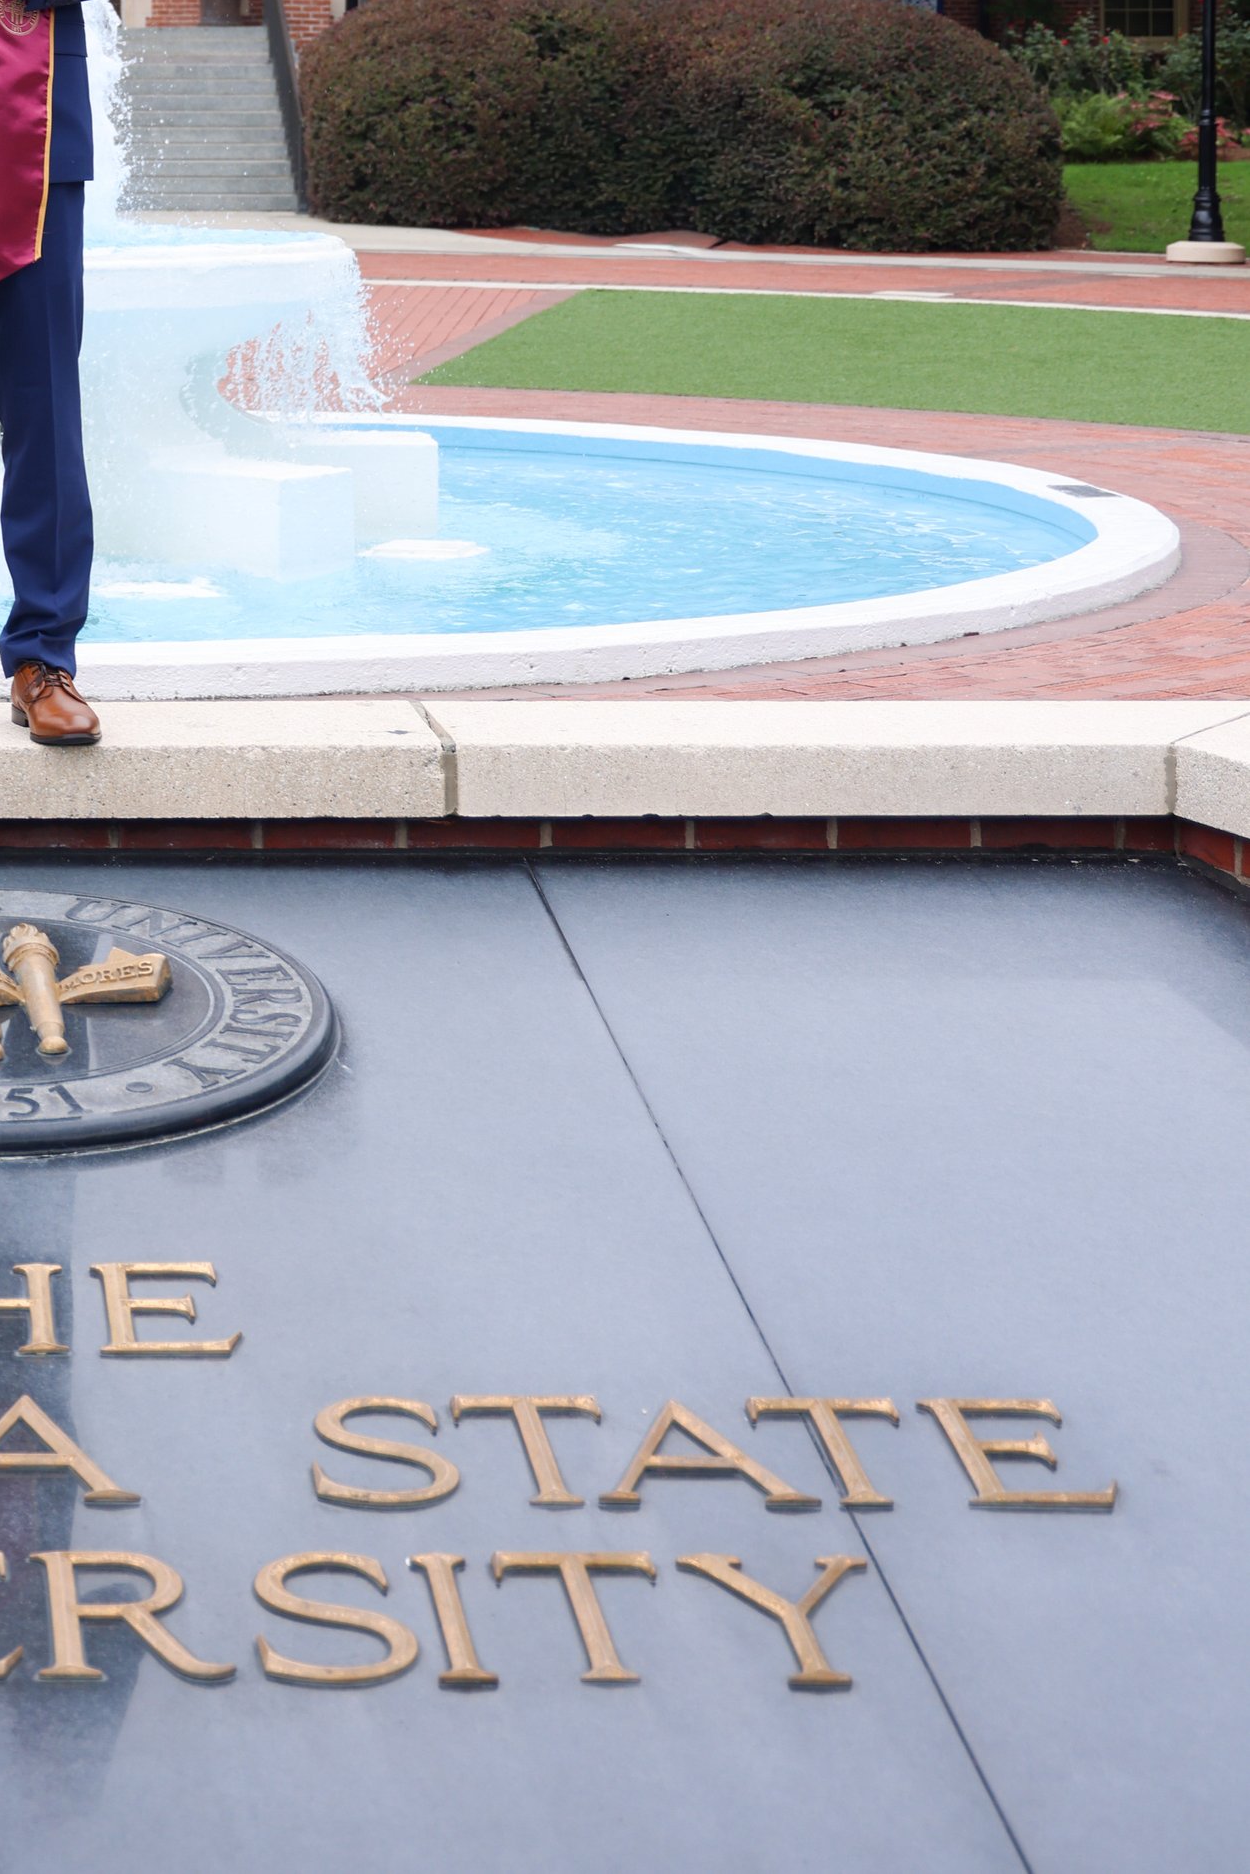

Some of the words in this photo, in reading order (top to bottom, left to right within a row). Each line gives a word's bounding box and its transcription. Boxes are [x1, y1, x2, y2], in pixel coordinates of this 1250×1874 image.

[58, 960, 154, 991] MORES
[65, 898, 303, 1089] UNIVERSITY
[311, 1394, 1119, 1514] STATE
